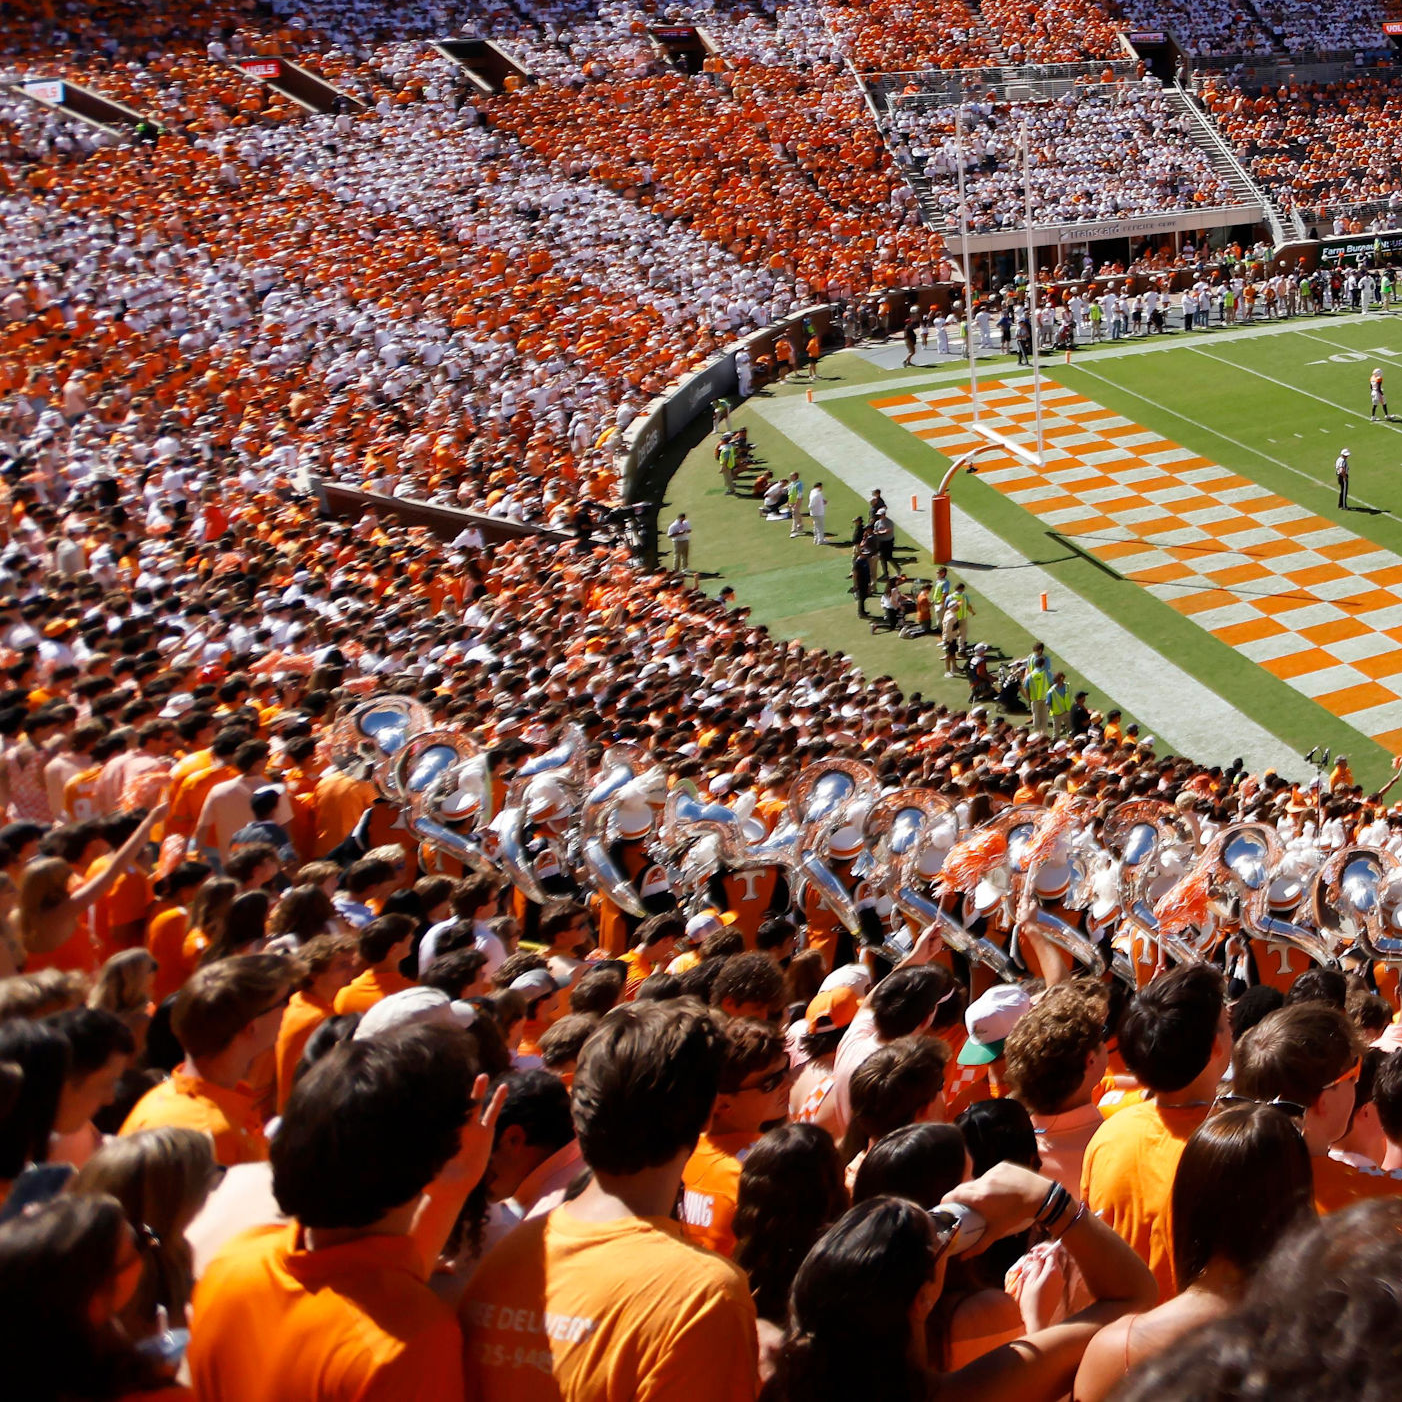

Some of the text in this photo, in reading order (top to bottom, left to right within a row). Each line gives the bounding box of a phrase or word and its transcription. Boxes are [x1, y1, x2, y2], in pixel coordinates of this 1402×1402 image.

[1070, 224, 1119, 239] Transcard
[1323, 244, 1375, 256] Farm Bureau
[733, 869, 766, 901] T
[1267, 943, 1293, 974] T
